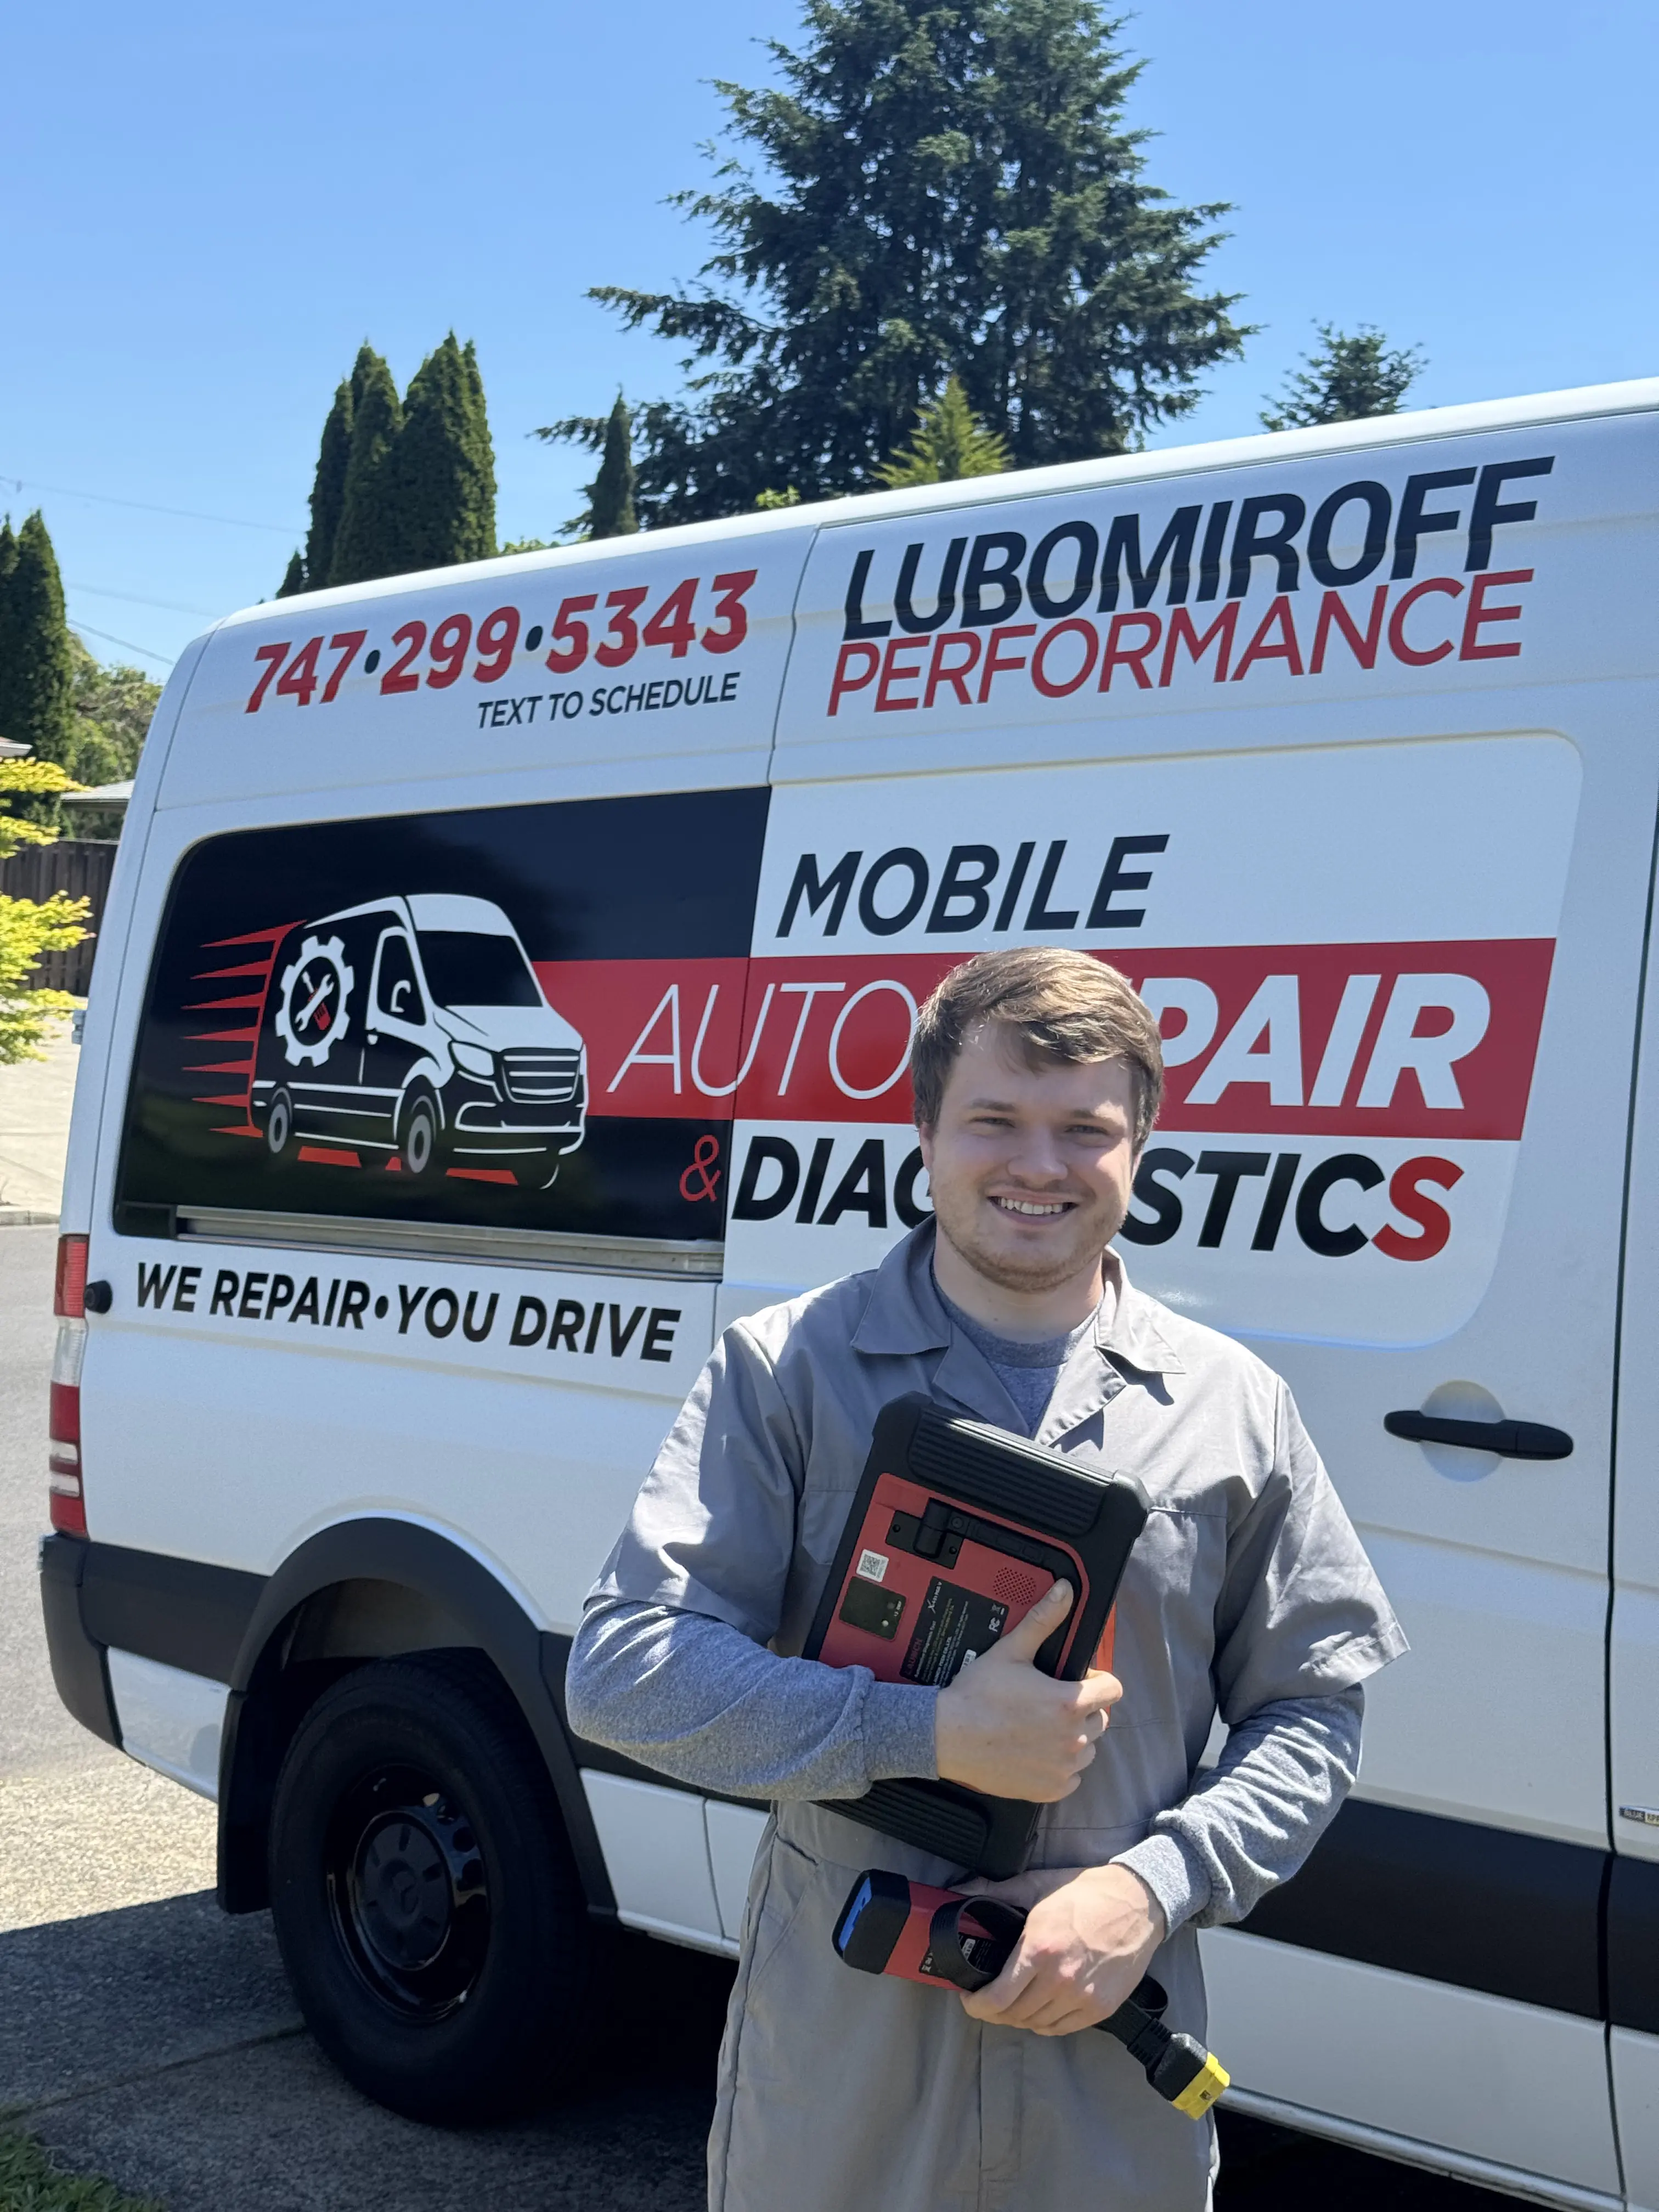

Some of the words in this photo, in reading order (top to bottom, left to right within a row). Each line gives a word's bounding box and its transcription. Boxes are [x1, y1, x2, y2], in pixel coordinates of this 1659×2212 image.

[843, 456, 1555, 641] LUBOMIROFF
[827, 568, 1534, 716] PERFORMANCE
[478, 696, 543, 729] TEXT
[549, 690, 583, 721] TO
[589, 672, 740, 717] SCHEDULE
[776, 834, 1170, 938] MOBILE
[607, 980, 918, 1099] AUTO
[1125, 973, 1491, 1110] PAIR
[679, 1135, 720, 1201] &
[137, 1262, 202, 1312] WE
[509, 1296, 681, 1362] DRIVE
